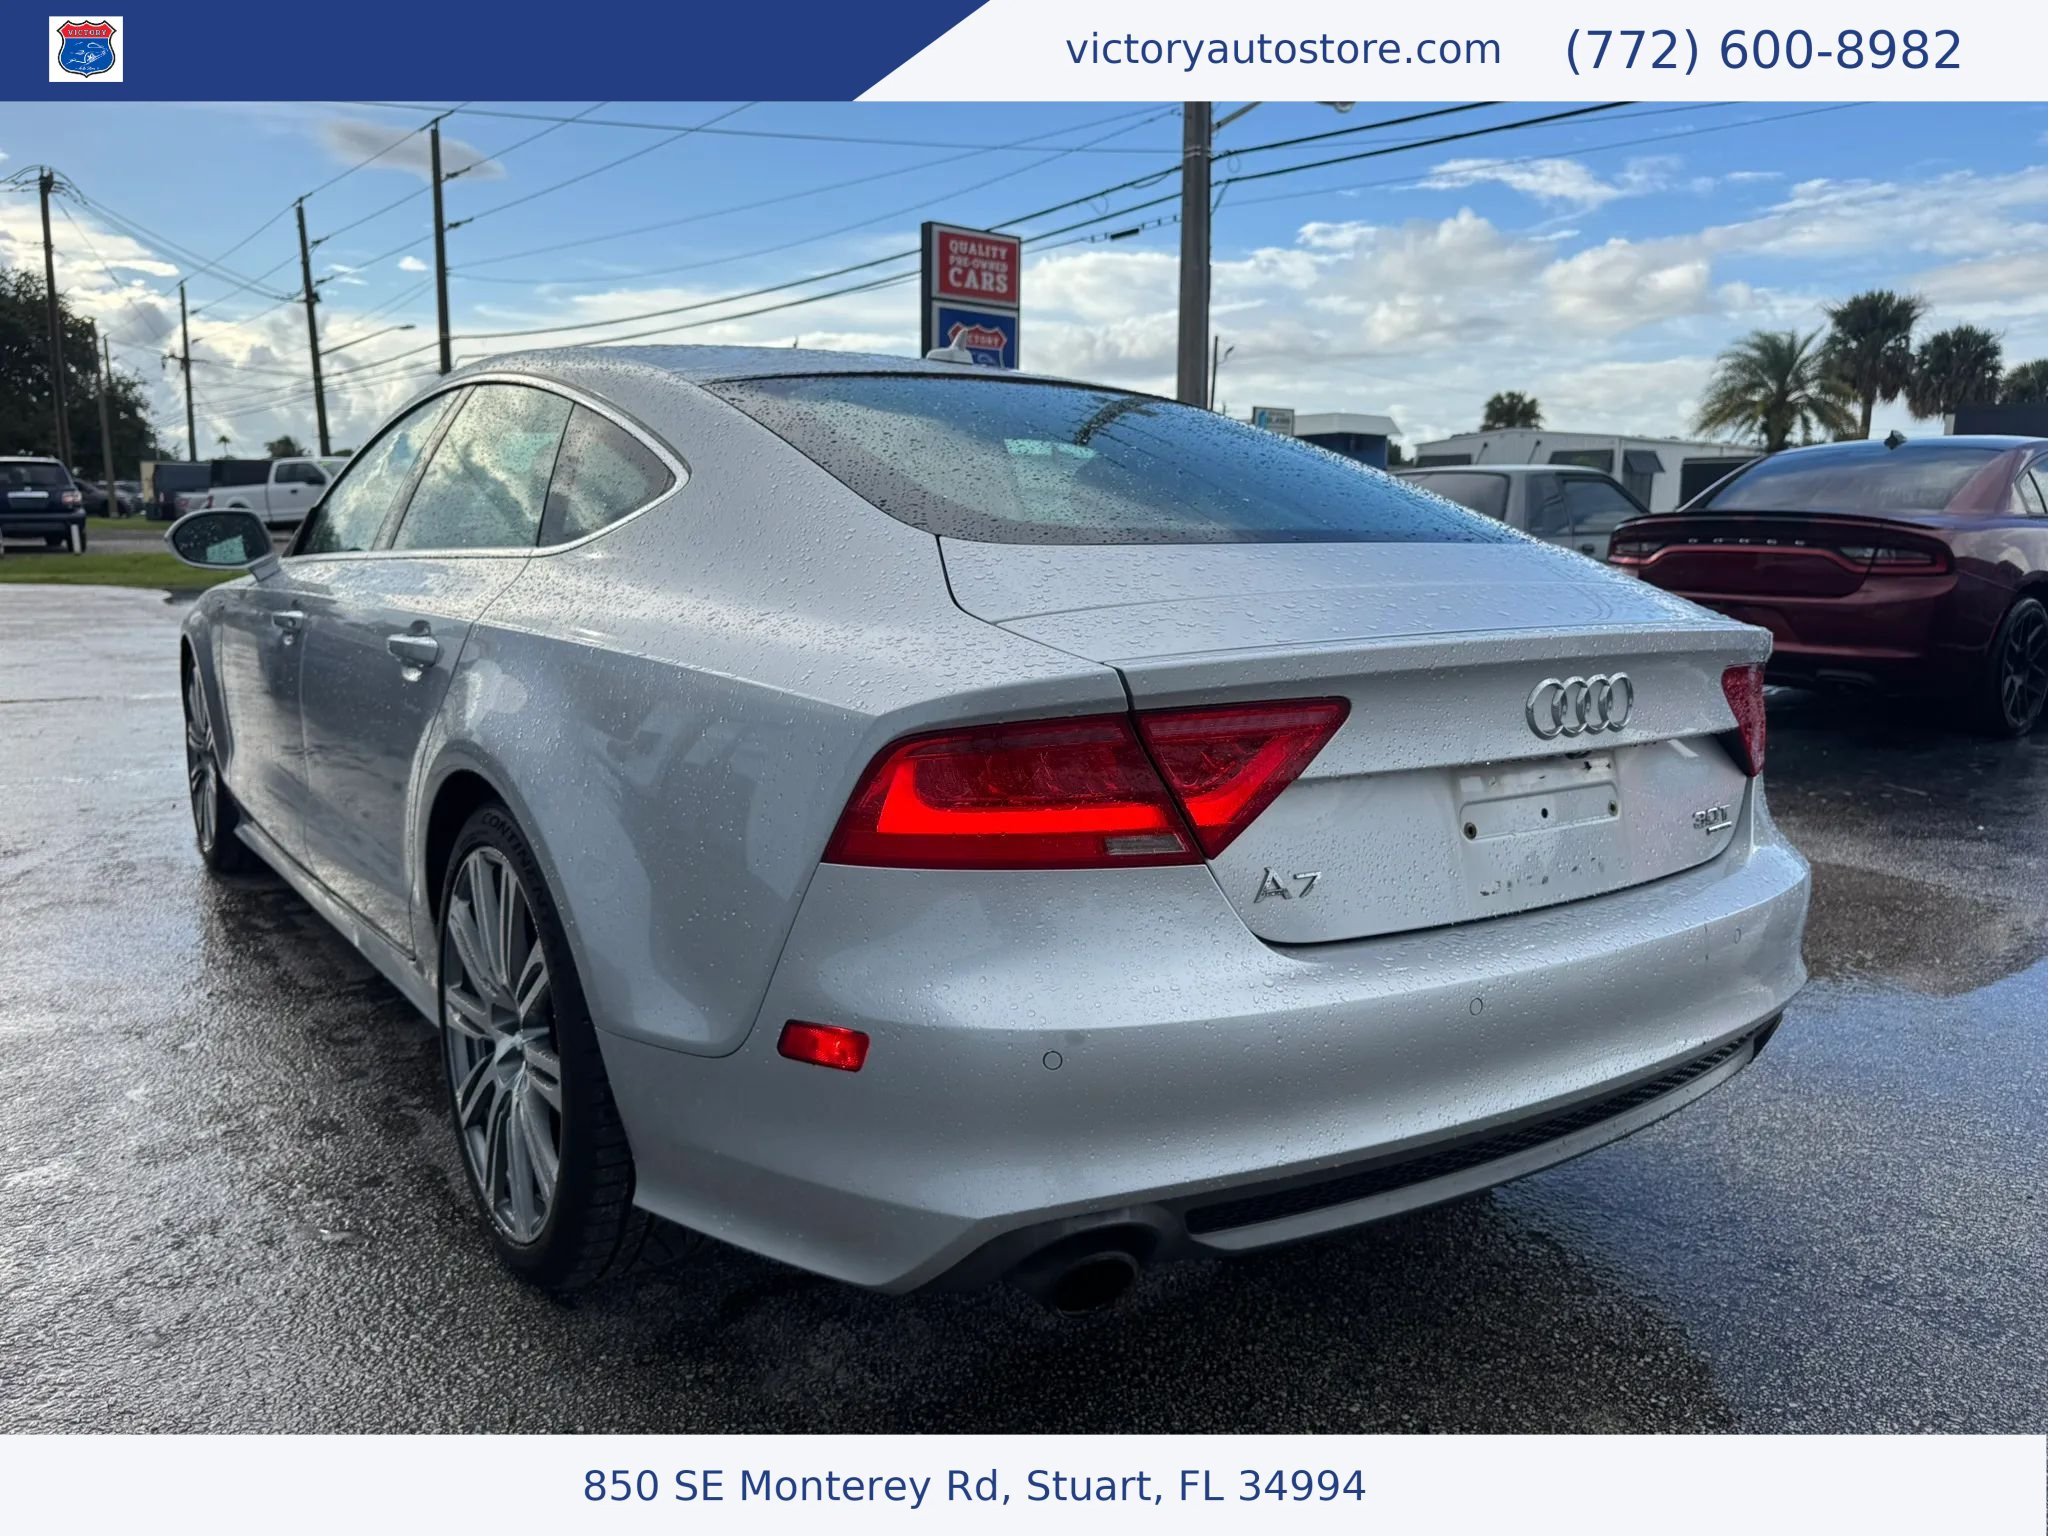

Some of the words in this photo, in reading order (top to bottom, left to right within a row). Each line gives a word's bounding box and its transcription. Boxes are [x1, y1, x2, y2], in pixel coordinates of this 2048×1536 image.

[949, 239, 1008, 260] QUALITY
[949, 255, 1008, 273] PRE-OWNED
[948, 267, 1008, 293] CARS
[1254, 866, 1322, 904] A7
